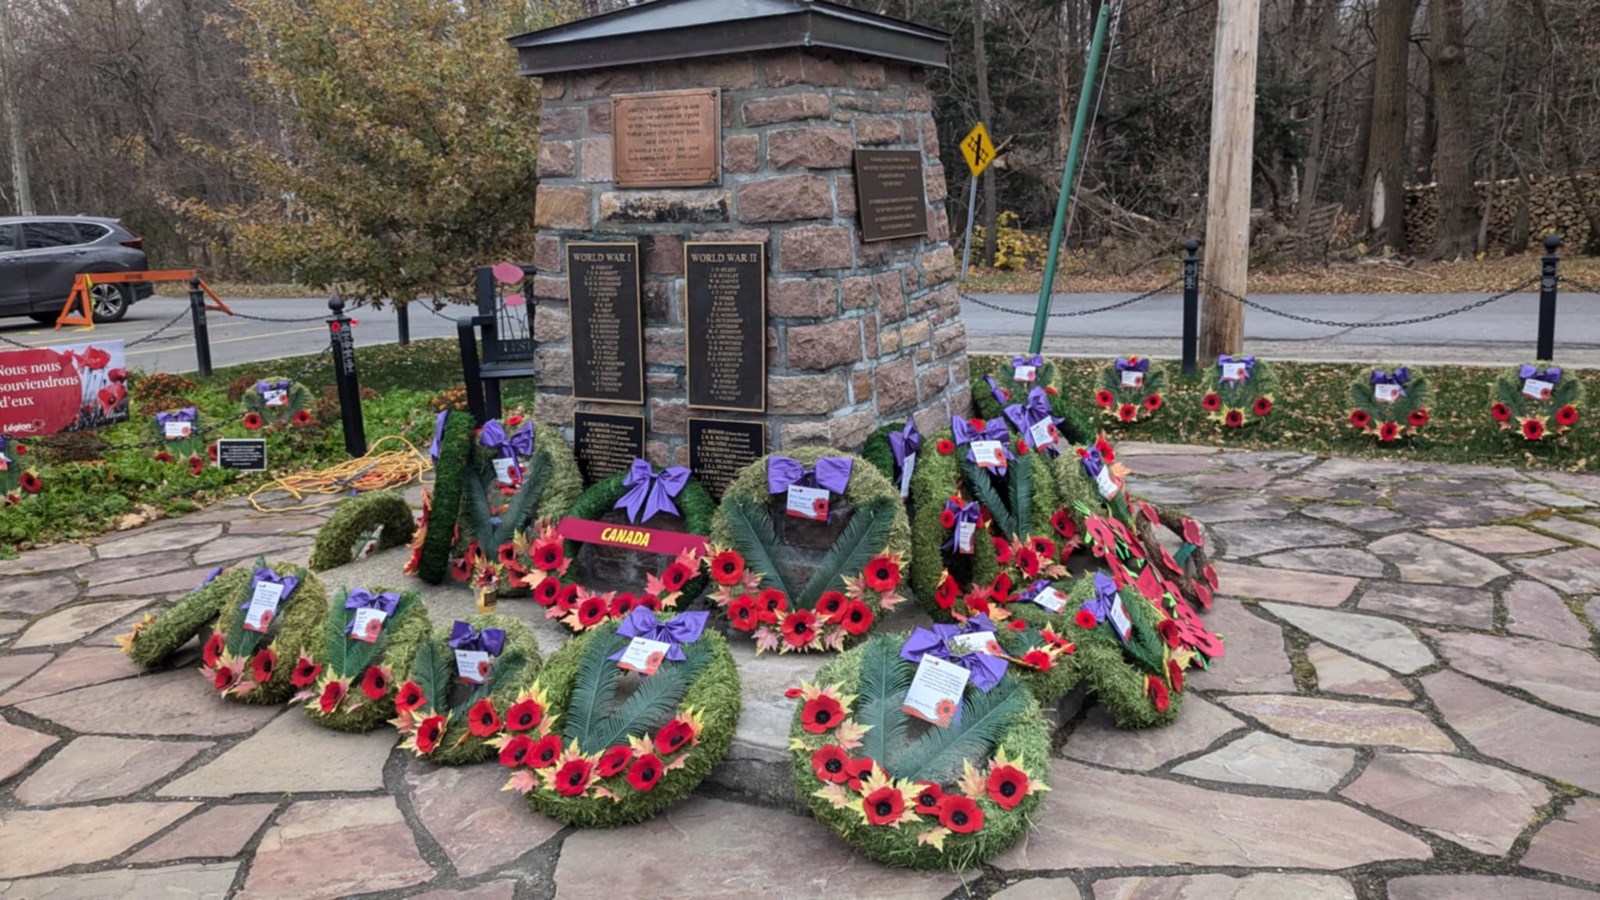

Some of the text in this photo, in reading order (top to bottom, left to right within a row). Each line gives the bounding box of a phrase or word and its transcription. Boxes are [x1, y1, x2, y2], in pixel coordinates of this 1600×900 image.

[573, 253, 631, 262] WORLD WAR I
[691, 253, 757, 262] WORLD WAR II
[31, 363, 61, 373] nous
[0, 376, 79, 392] souviendrons
[3, 424, 32, 432] Légion
[601, 527, 650, 547] CANADA
